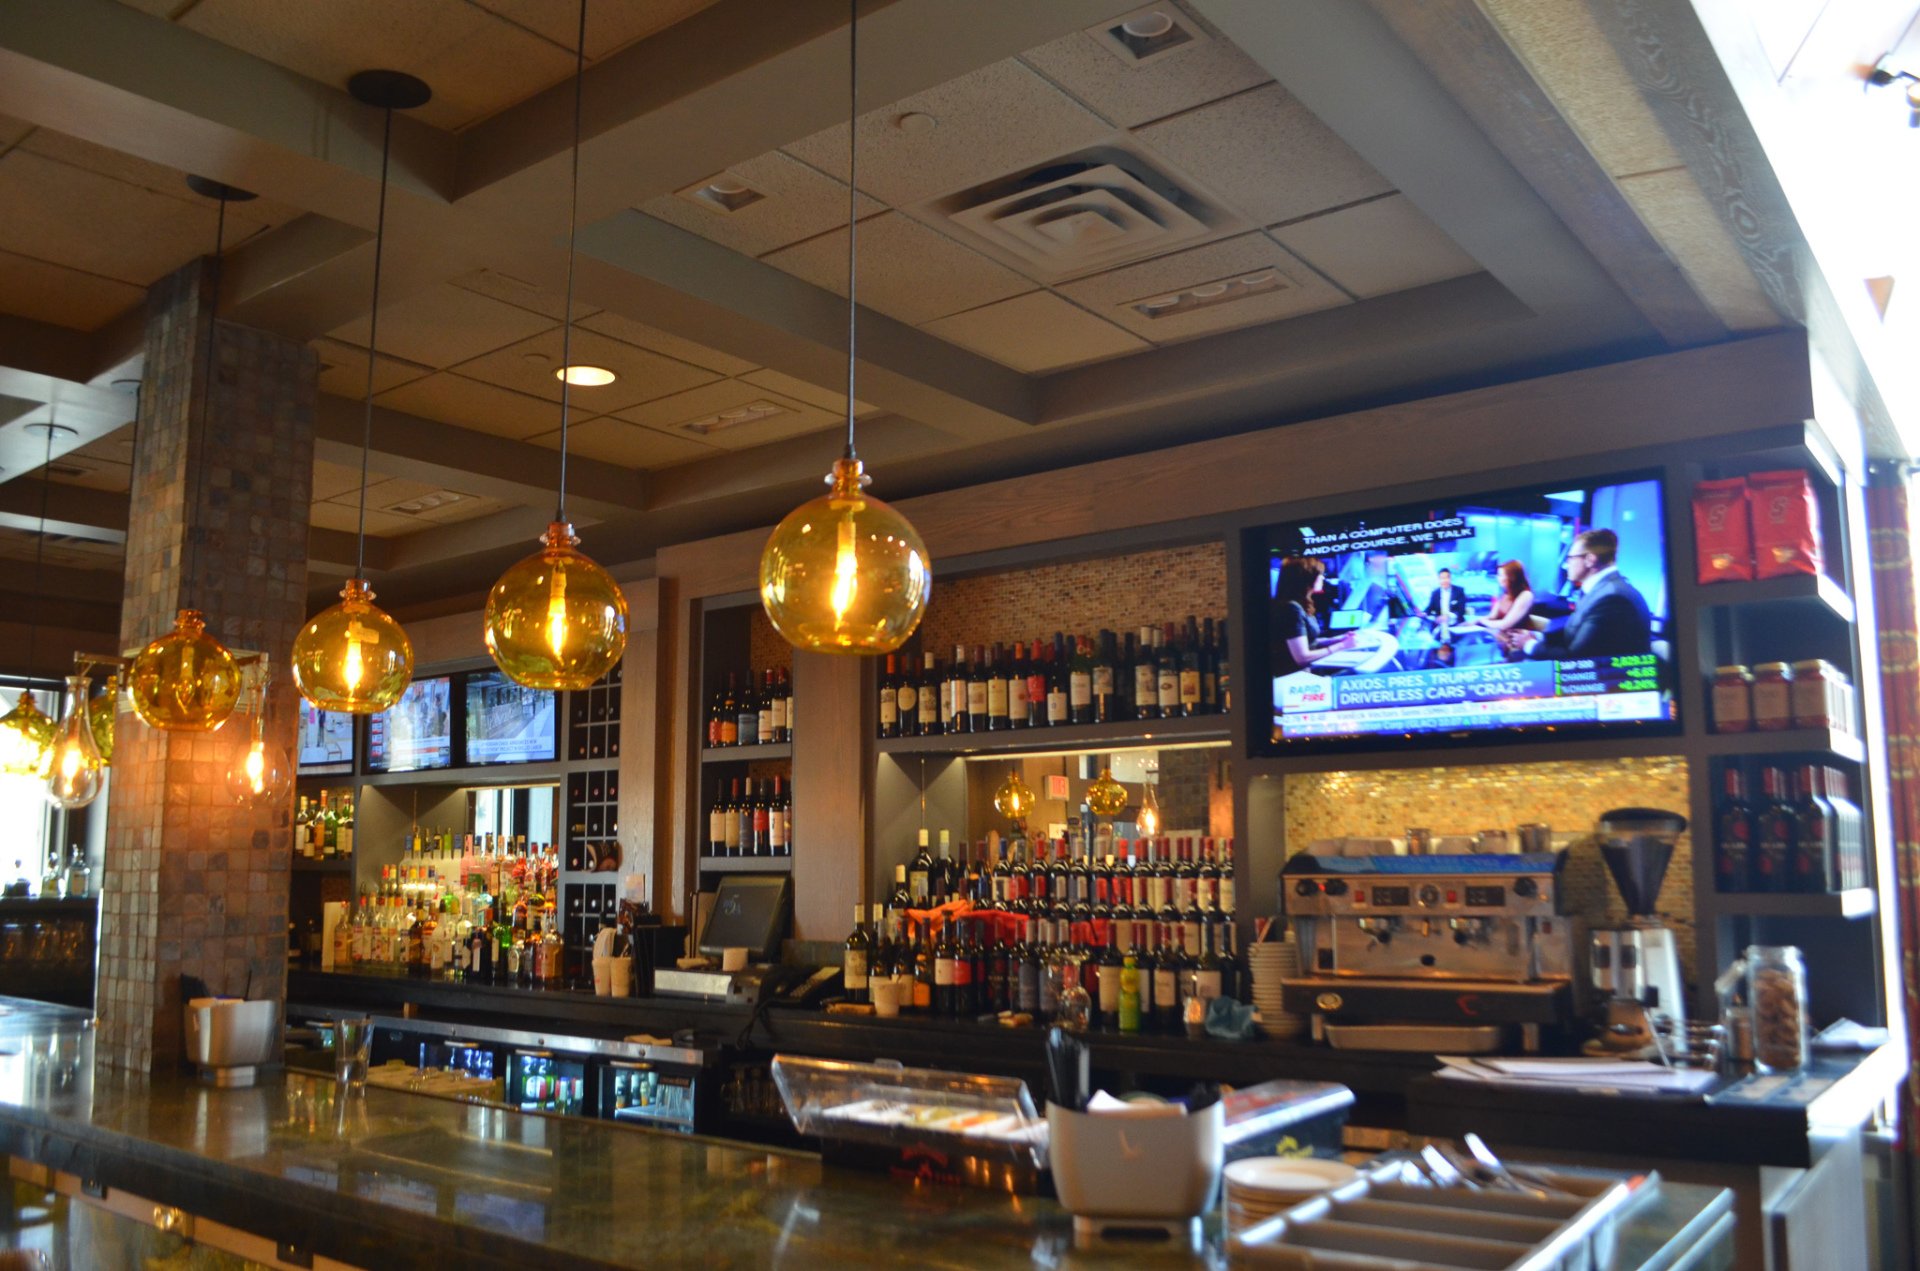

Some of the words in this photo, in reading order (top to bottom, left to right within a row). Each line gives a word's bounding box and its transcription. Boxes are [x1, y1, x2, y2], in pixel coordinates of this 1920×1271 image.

[1302, 534, 1337, 545] THAN
[1338, 532, 1348, 541] A
[1349, 522, 1423, 539] COMPUTER
[1424, 517, 1464, 530] DOES
[1303, 546, 1329, 556] AND
[1329, 543, 1350, 552] OF
[1411, 533, 1434, 543] WE
[1437, 527, 1472, 539] TALK
[1289, 684, 1322, 695] RAPID
[1340, 677, 1386, 692] AXIOS:
[1388, 674, 1427, 689] PRES.
[1429, 669, 1479, 685] TRUMP
[1482, 666, 1523, 682] SAYS
[1302, 692, 1326, 702] FIRE
[1340, 687, 1425, 705] DRIVERLESS
[1426, 685, 1467, 699] CARS
[1468, 680, 1533, 697] "CRAZY"
